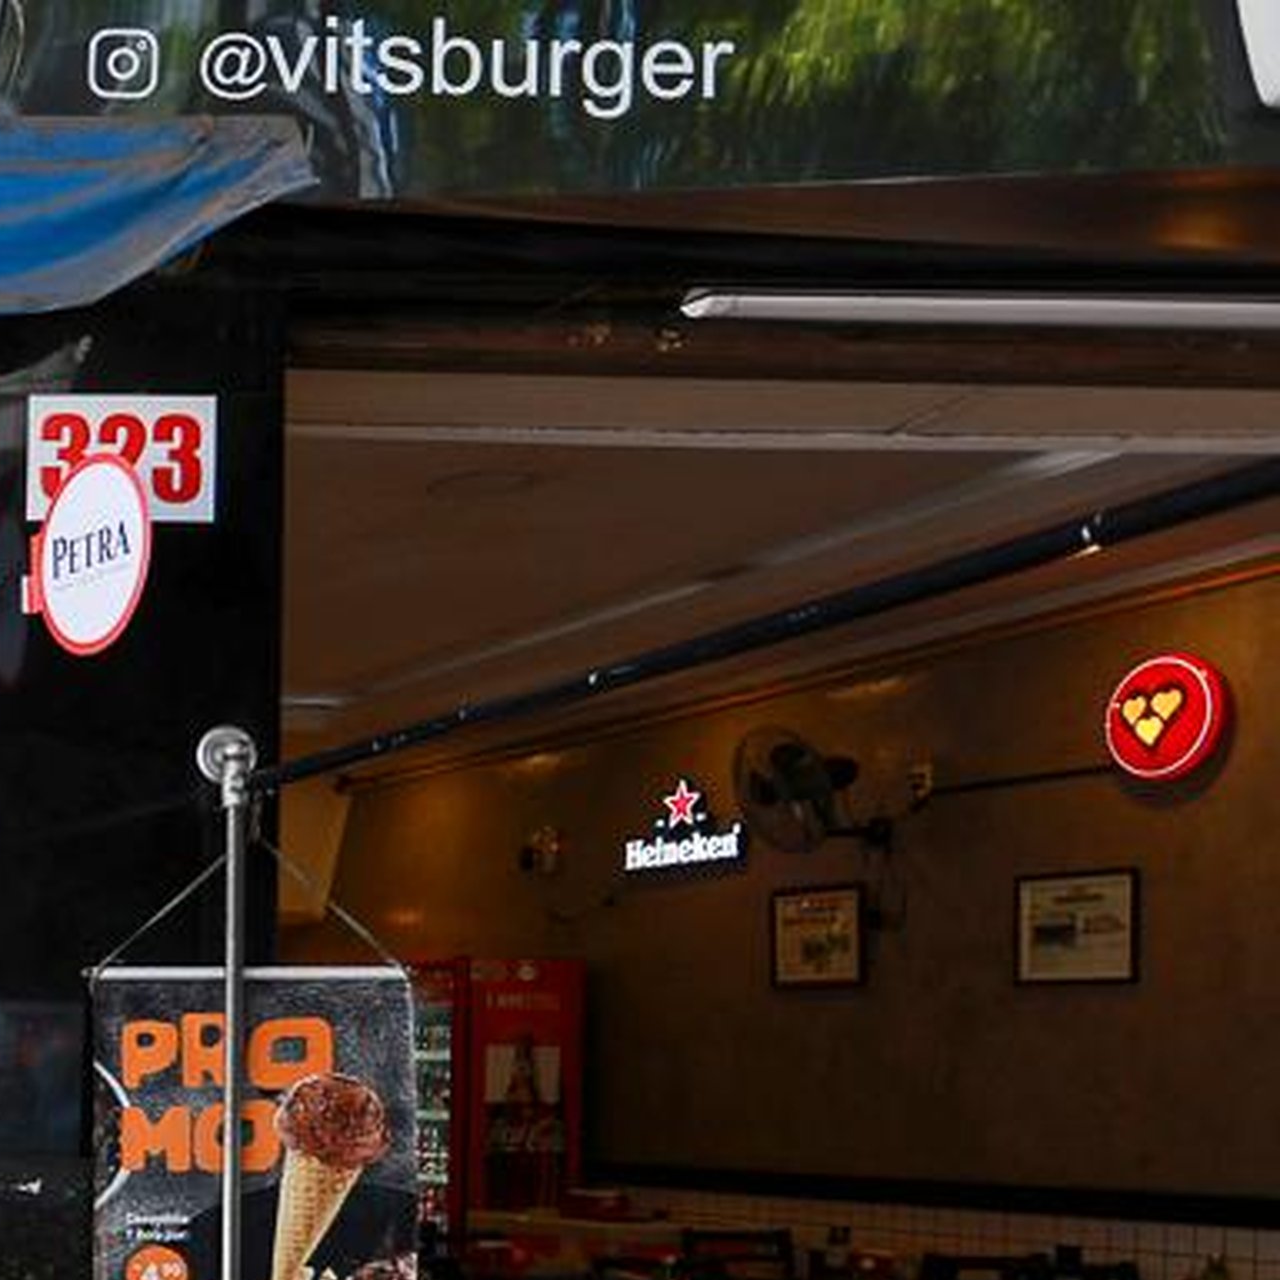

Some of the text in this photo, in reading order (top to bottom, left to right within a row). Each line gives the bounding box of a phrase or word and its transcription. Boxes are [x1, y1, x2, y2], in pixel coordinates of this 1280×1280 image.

[200, 17, 735, 118] @vitsburger
[51, 520, 131, 581] PETRA
[624, 822, 740, 870] Heineken
[120, 1012, 335, 1089] PRO
[119, 1099, 282, 1173] MO
